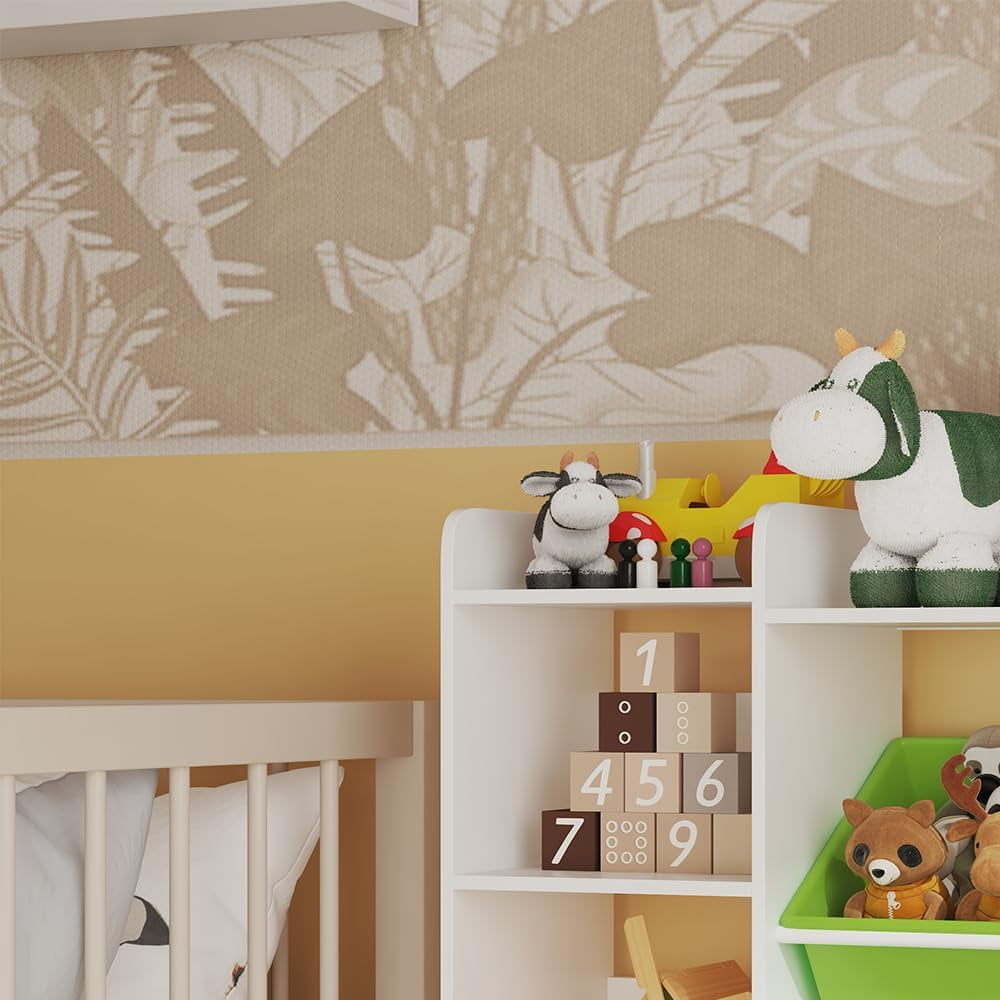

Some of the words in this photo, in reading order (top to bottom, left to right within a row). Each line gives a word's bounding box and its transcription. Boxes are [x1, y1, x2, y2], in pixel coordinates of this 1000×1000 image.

[636, 638, 658, 687] 1
[580, 758, 613, 806] 4
[635, 758, 668, 807] 5
[695, 759, 726, 808] 6
[551, 817, 585, 865] 7
[668, 819, 698, 868] 9
